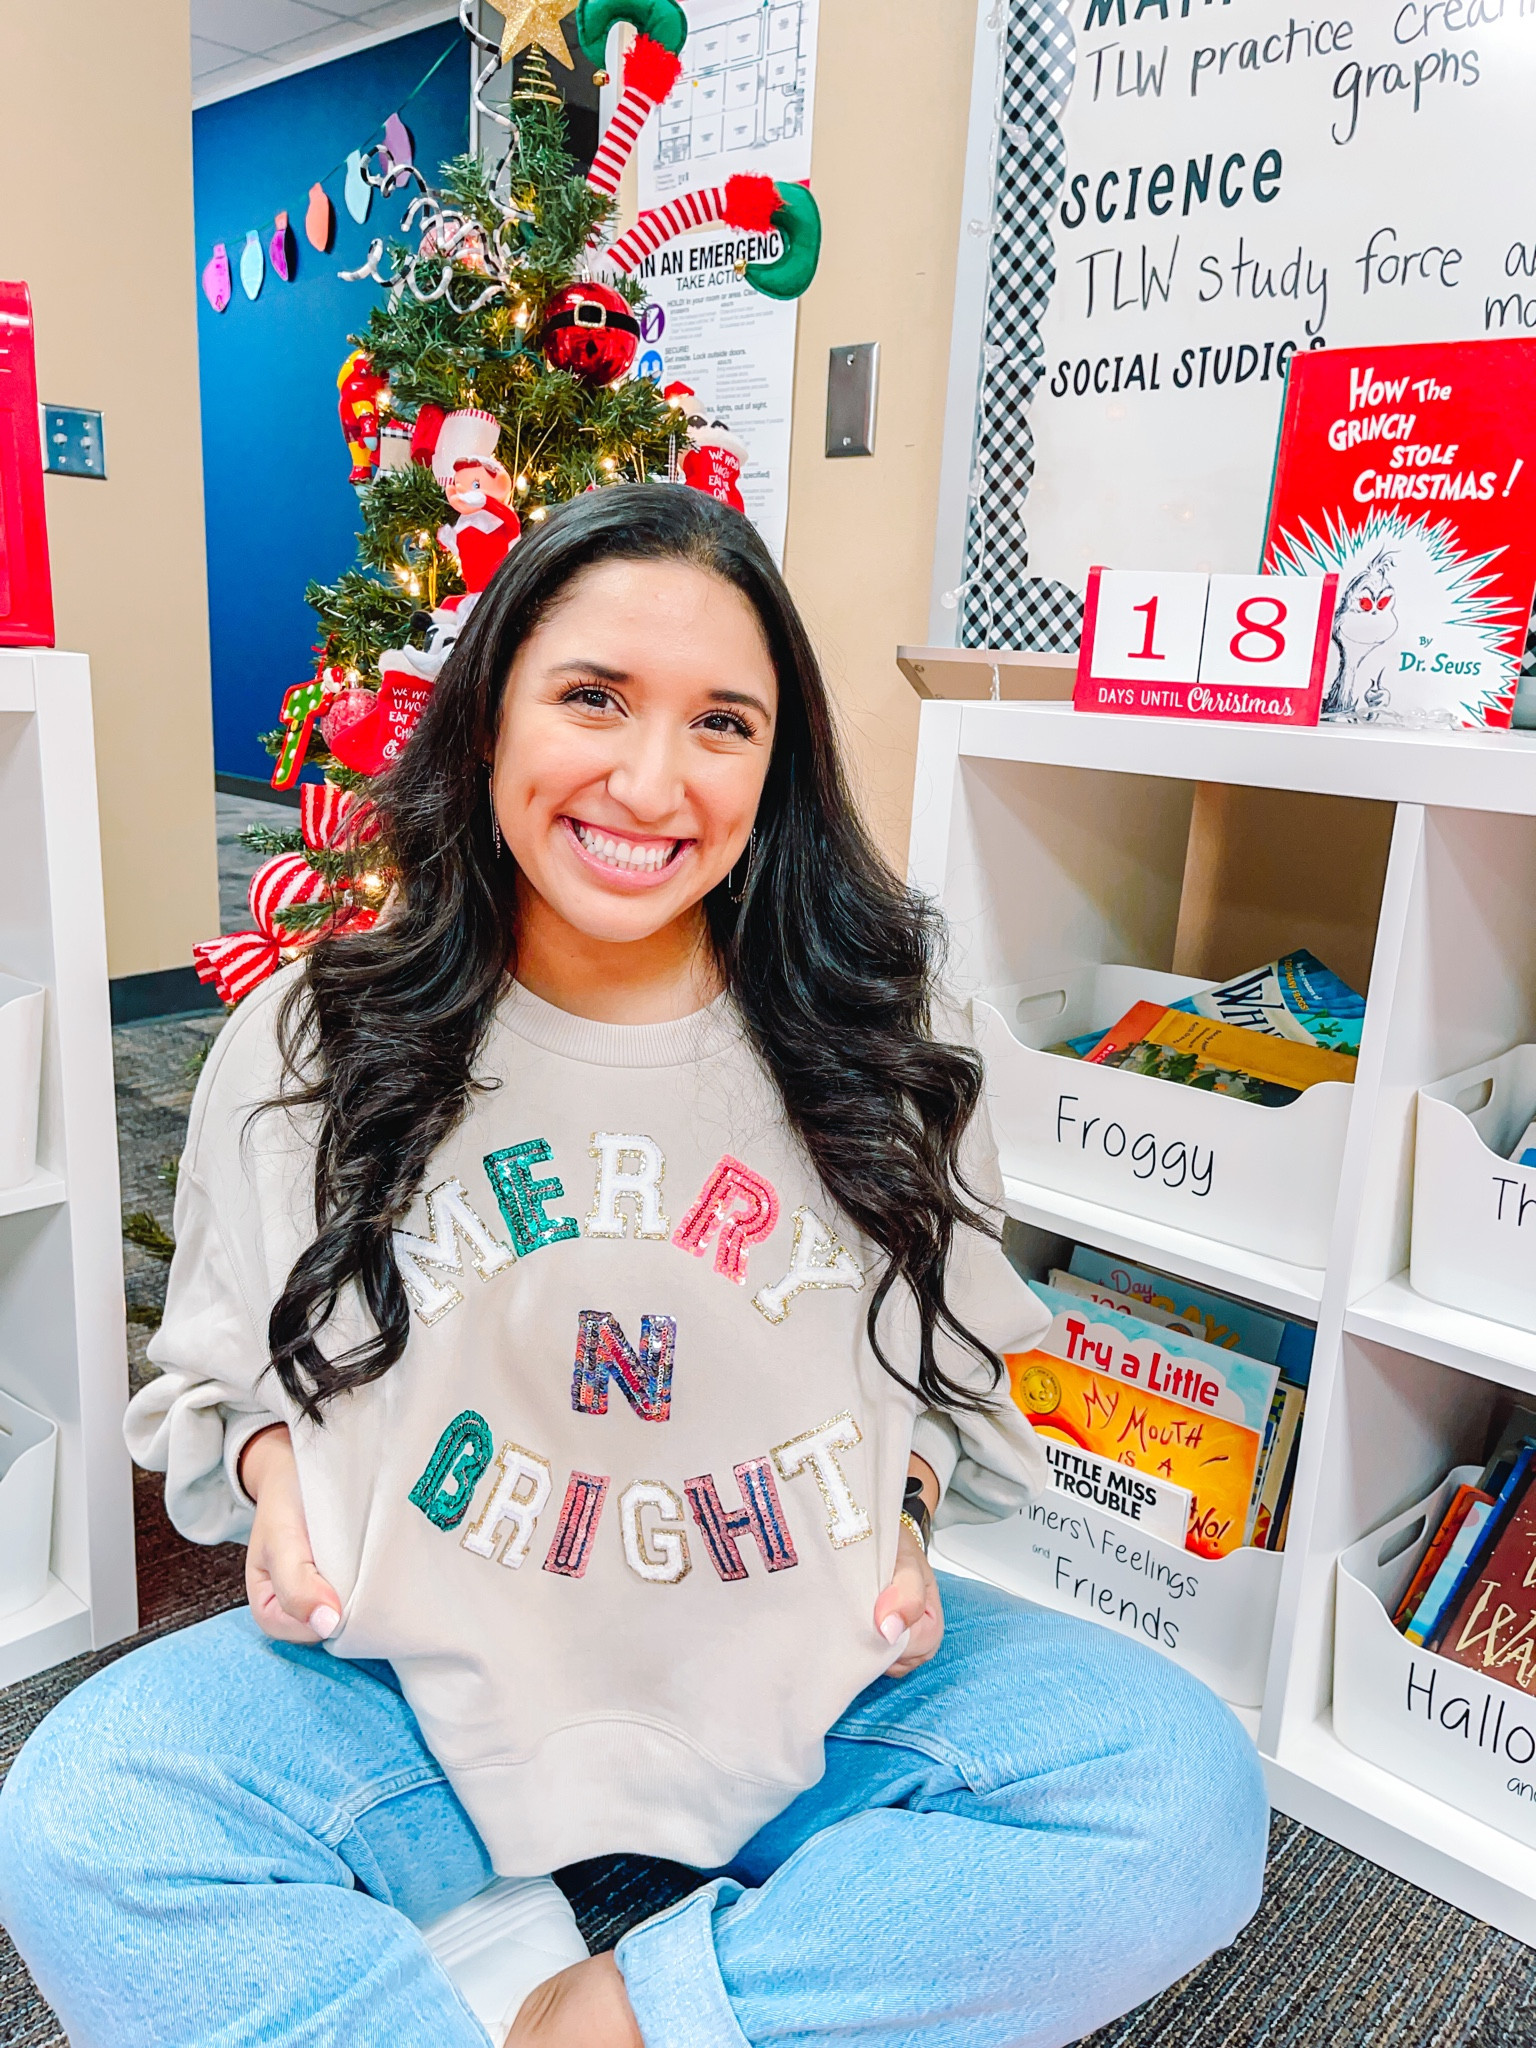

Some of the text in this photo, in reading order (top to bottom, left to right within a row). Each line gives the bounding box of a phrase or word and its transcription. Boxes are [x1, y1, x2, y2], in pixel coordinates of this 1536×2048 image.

[1086, 0, 1536, 102] TLW practice crea
[1332, 48, 1480, 145] graphs
[661, 250, 683, 276] AN
[690, 233, 784, 271] EMERGENC
[676, 270, 744, 291] TAKE ACTIO
[1076, 235, 1179, 318] TLW
[1199, 237, 1328, 336] study
[1355, 227, 1462, 294] force
[1050, 352, 1160, 397] SOCIAL
[1328, 413, 1417, 451] GRINCH
[1389, 444, 1459, 469] STOLE
[1399, 652, 1482, 676] Dr. Seuss
[1419, 636, 1433, 648] By
[389, 711, 409, 725] EAT
[1099, 687, 1295, 717] DAYS UNTIL Christmas
[1057, 1095, 1214, 1197] Froggy
[392, 1132, 866, 1327] MERRY
[572, 1310, 677, 1423] N
[1066, 1318, 1113, 1372] Try
[1121, 1353, 1140, 1379] a
[1148, 1353, 1219, 1407] Little
[1046, 1446, 1157, 1506] LITTLE MISS
[1157, 1458, 1174, 1477] A
[408, 1409, 873, 1584] BRIGHT
[1053, 1468, 1142, 1521] TROUBLE
[1032, 1544, 1050, 1559] and
[1055, 1555, 1180, 1649] Friends
